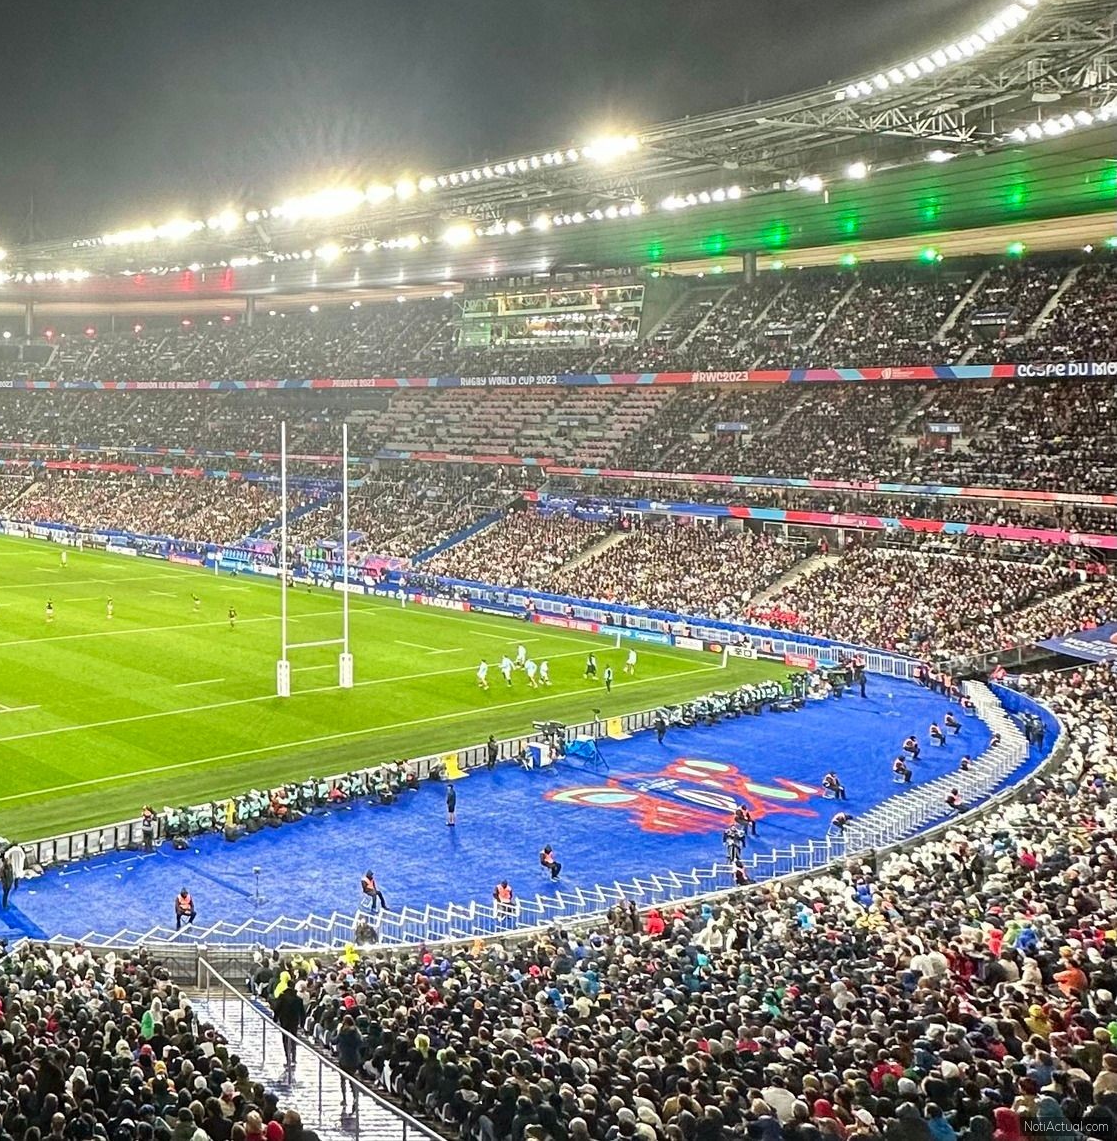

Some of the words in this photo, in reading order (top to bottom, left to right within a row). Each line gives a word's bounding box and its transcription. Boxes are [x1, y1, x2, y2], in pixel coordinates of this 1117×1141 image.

[1068, 362, 1089, 376] DU
[460, 377, 487, 386] RUGBY
[488, 376, 517, 386] WORLD
[518, 376, 535, 385] CUP
[536, 375, 557, 385] 2023
[691, 371, 749, 382] #RWC2023
